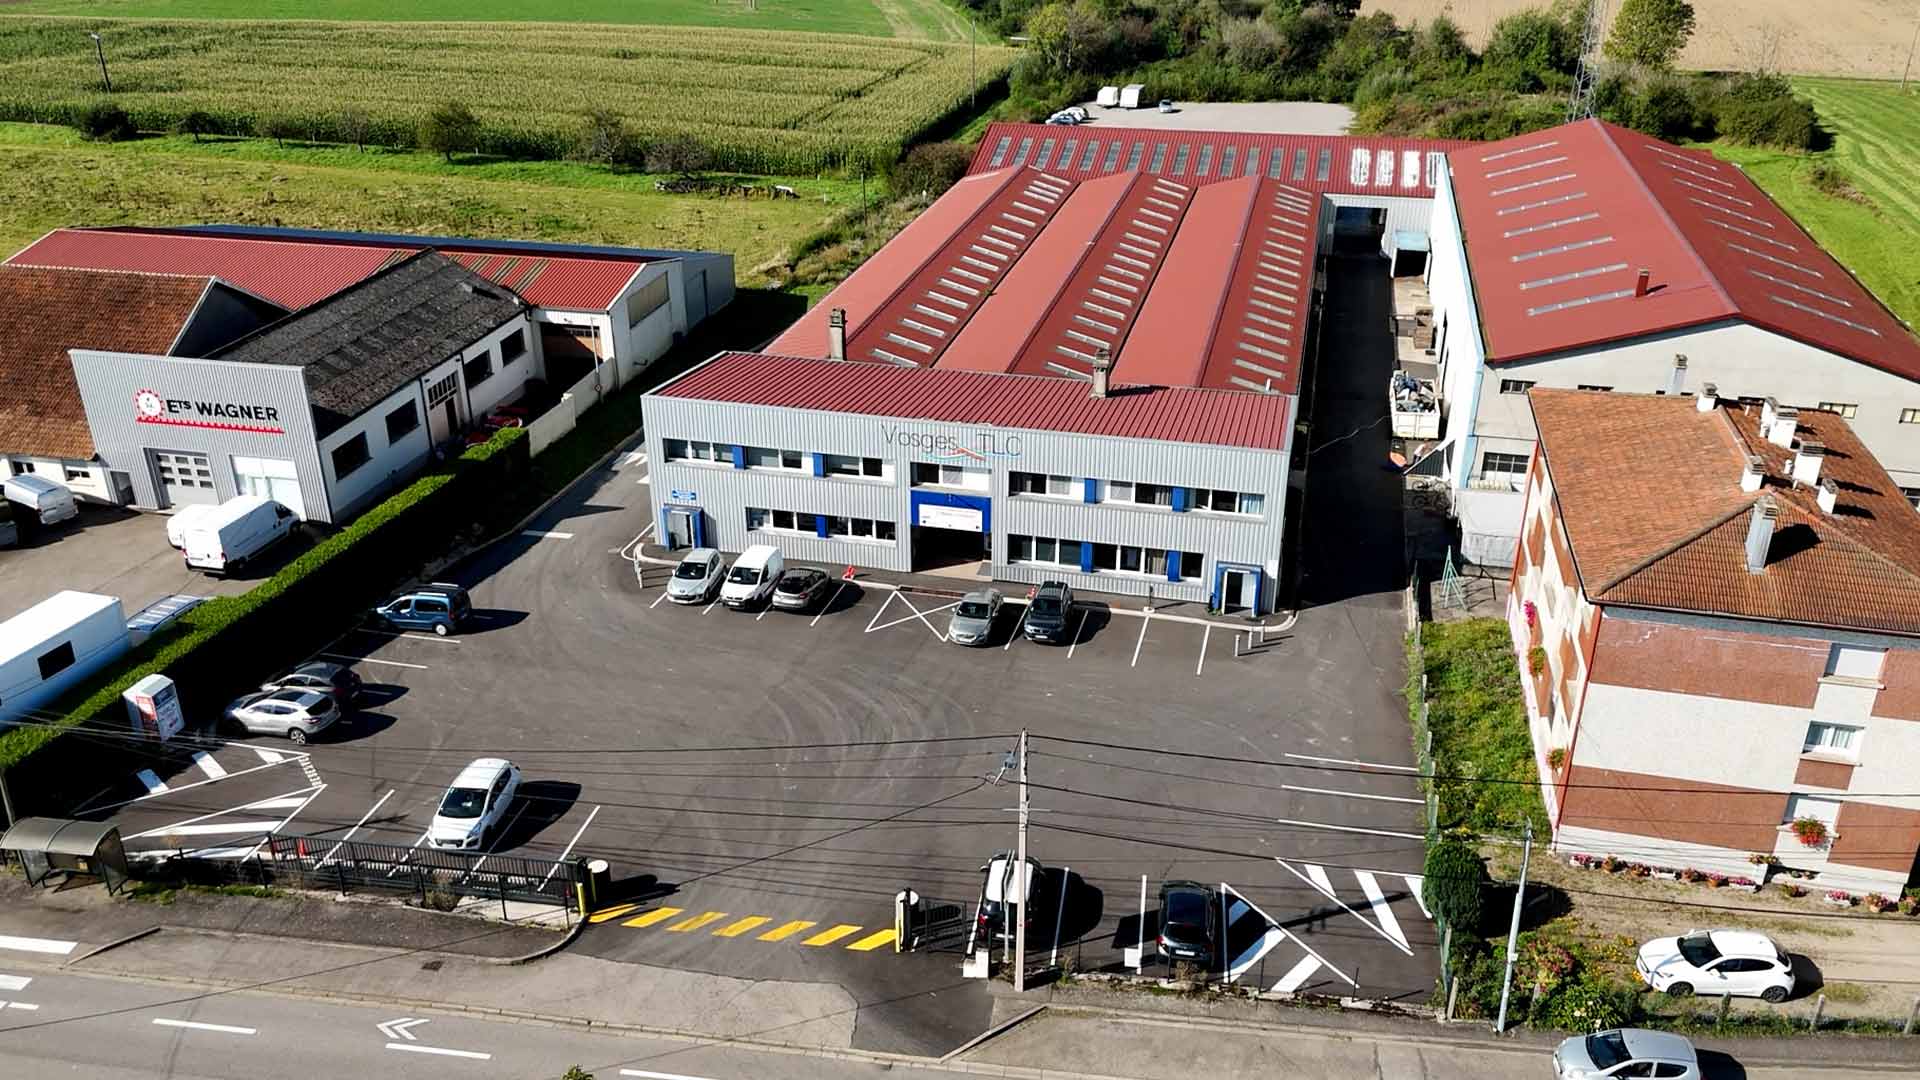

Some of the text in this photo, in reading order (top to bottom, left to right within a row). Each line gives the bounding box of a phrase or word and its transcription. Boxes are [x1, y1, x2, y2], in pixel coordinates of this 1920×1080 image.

[194, 401, 279, 421] WAGNER
[881, 424, 1021, 457] Vosges TLC
